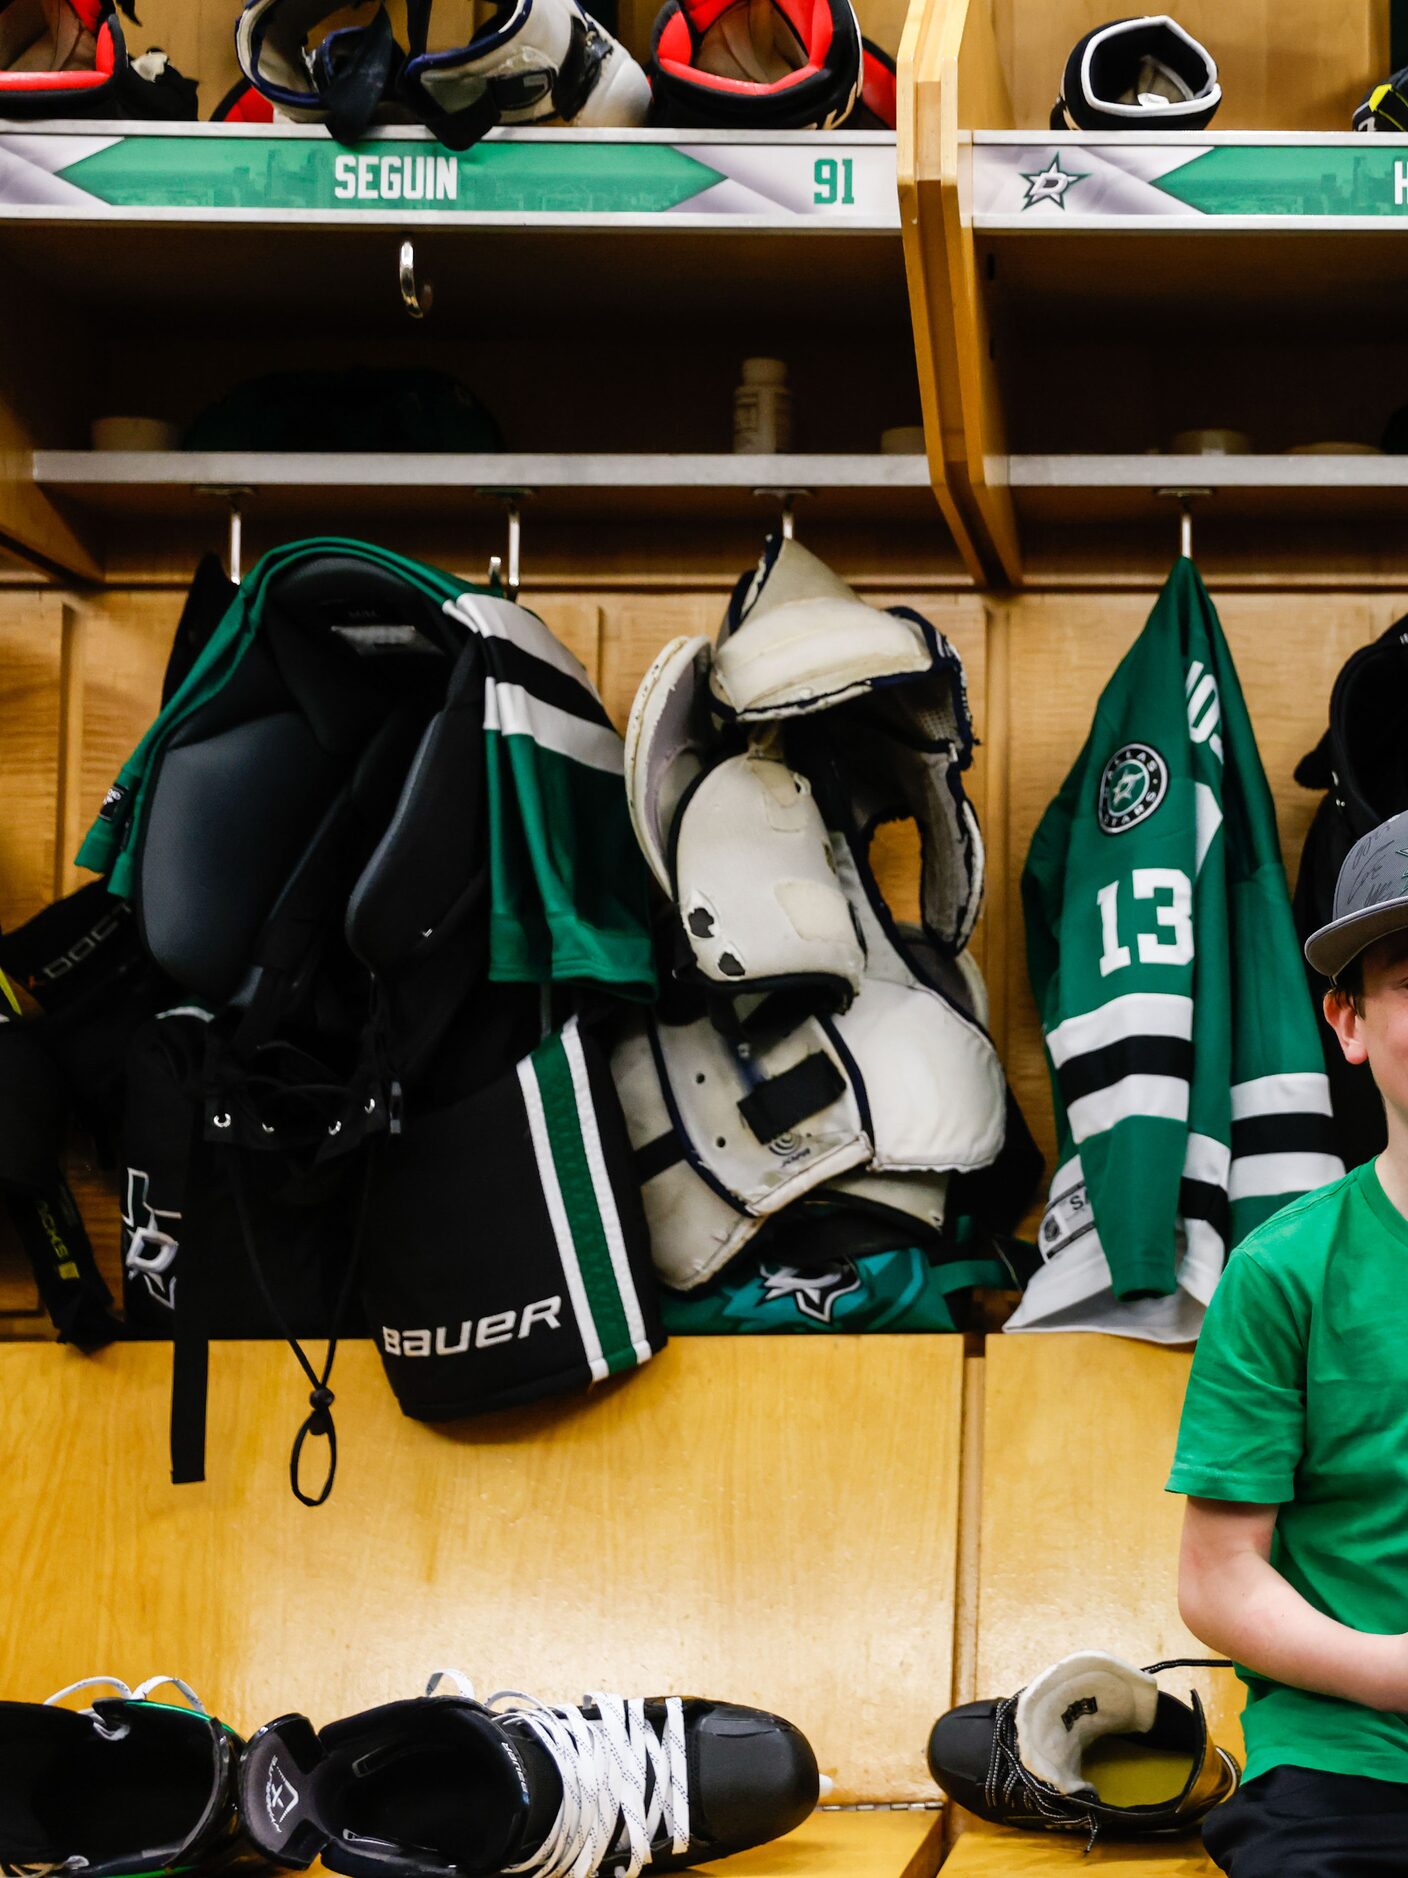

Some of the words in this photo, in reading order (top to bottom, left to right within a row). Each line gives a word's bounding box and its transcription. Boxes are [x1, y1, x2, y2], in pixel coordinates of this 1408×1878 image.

[334, 155, 458, 200] SEGUIN
[813, 158, 855, 205] 91
[1096, 867, 1195, 978] 13
[382, 1295, 562, 1357] BAUER
